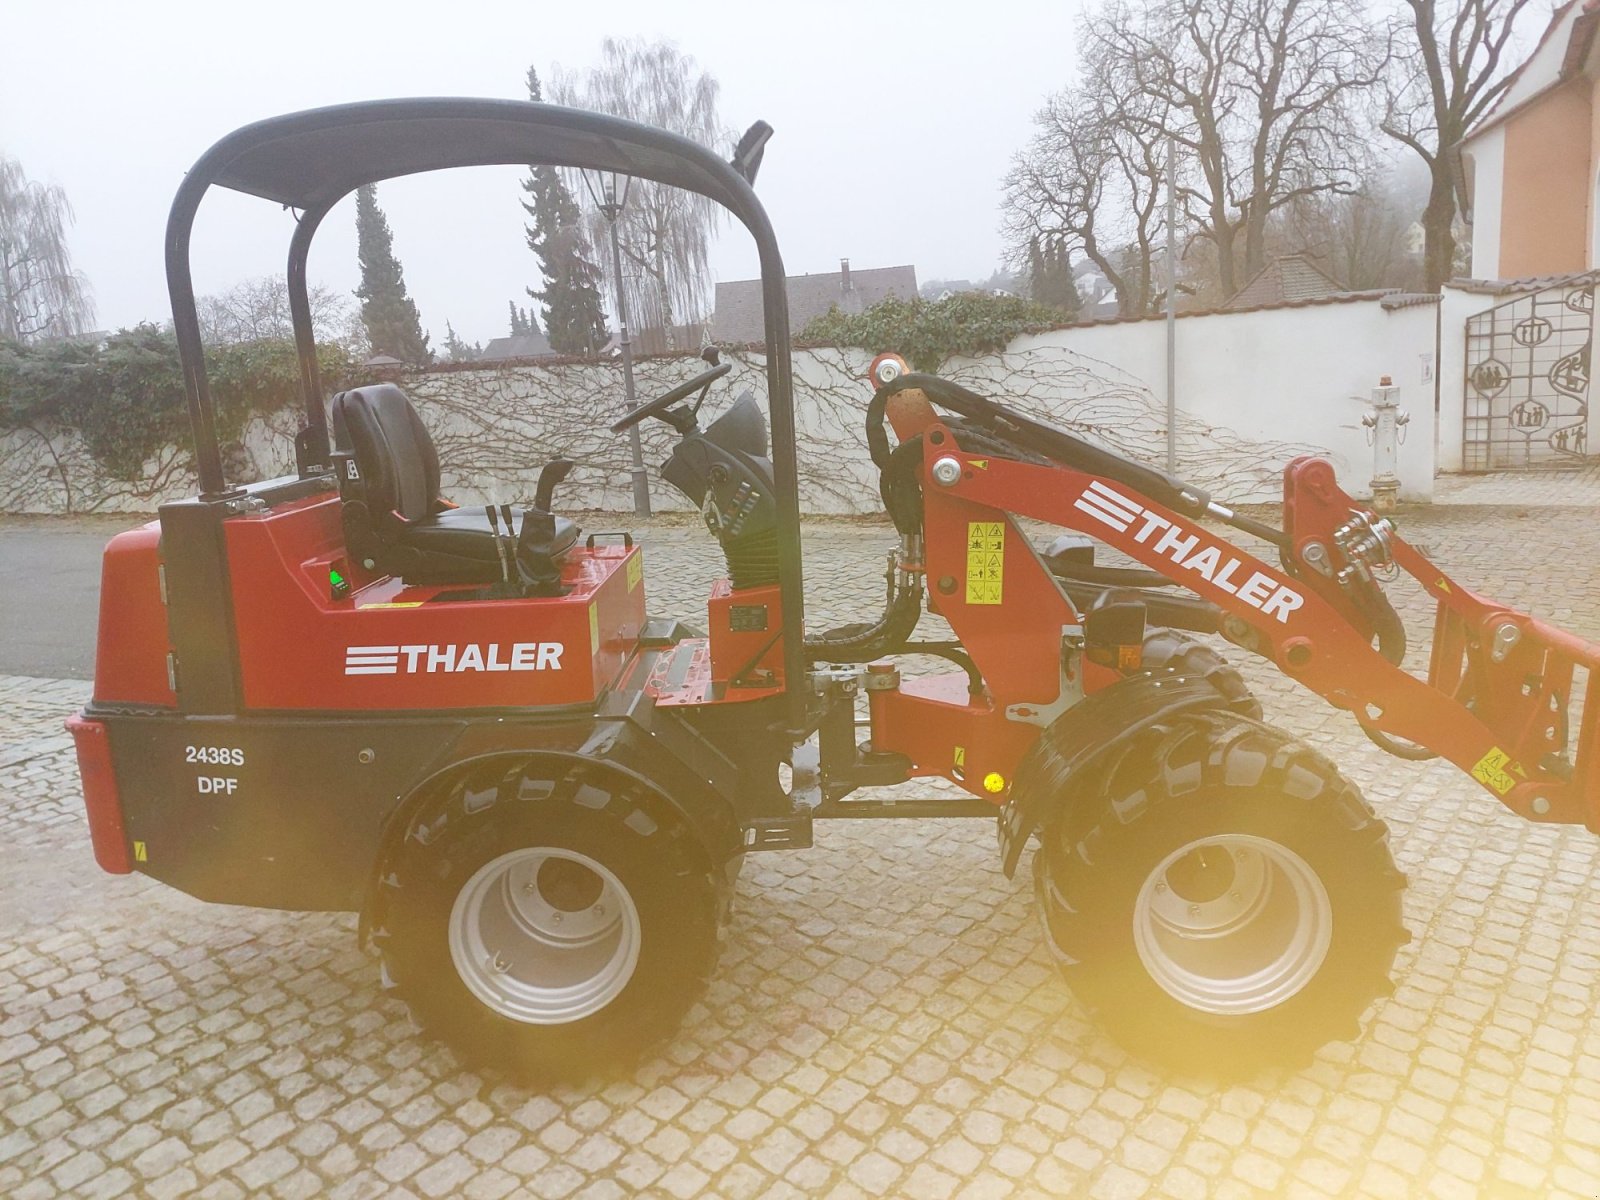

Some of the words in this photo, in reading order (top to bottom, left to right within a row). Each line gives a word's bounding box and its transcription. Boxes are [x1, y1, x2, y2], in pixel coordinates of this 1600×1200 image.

[1133, 509, 1304, 624] THALER
[400, 642, 564, 673] THALER
[185, 745, 245, 766] 2438S
[197, 776, 238, 795] DPF
